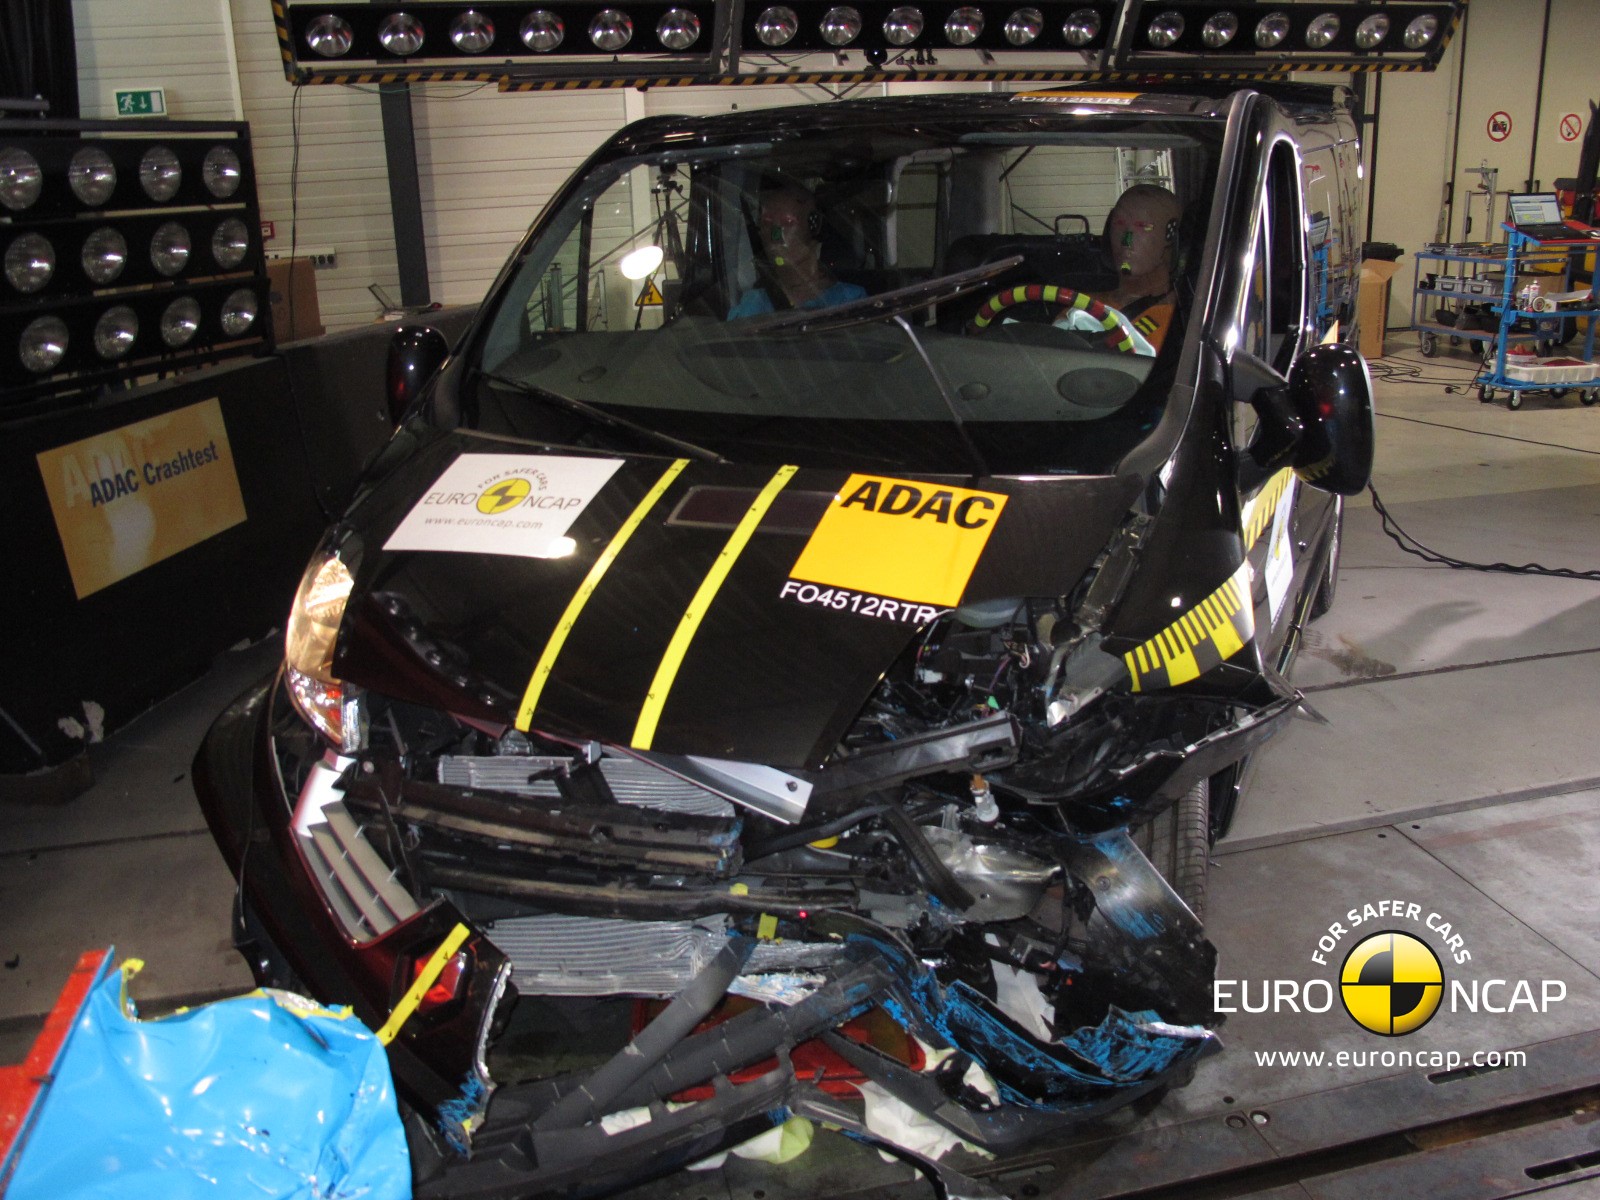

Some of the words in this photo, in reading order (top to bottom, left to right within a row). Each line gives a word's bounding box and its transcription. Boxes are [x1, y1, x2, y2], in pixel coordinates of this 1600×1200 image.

[90, 469, 140, 508] ADAC
[143, 440, 219, 486] Crashtest
[477, 474, 500, 489] FOR
[504, 467, 539, 477] SAFER
[424, 492, 477, 505] EURO
[523, 496, 582, 511] NCAP
[840, 480, 996, 530] ADAC
[424, 517, 543, 530] www.euroncap.com
[779, 581, 951, 625] FO4512RTR
